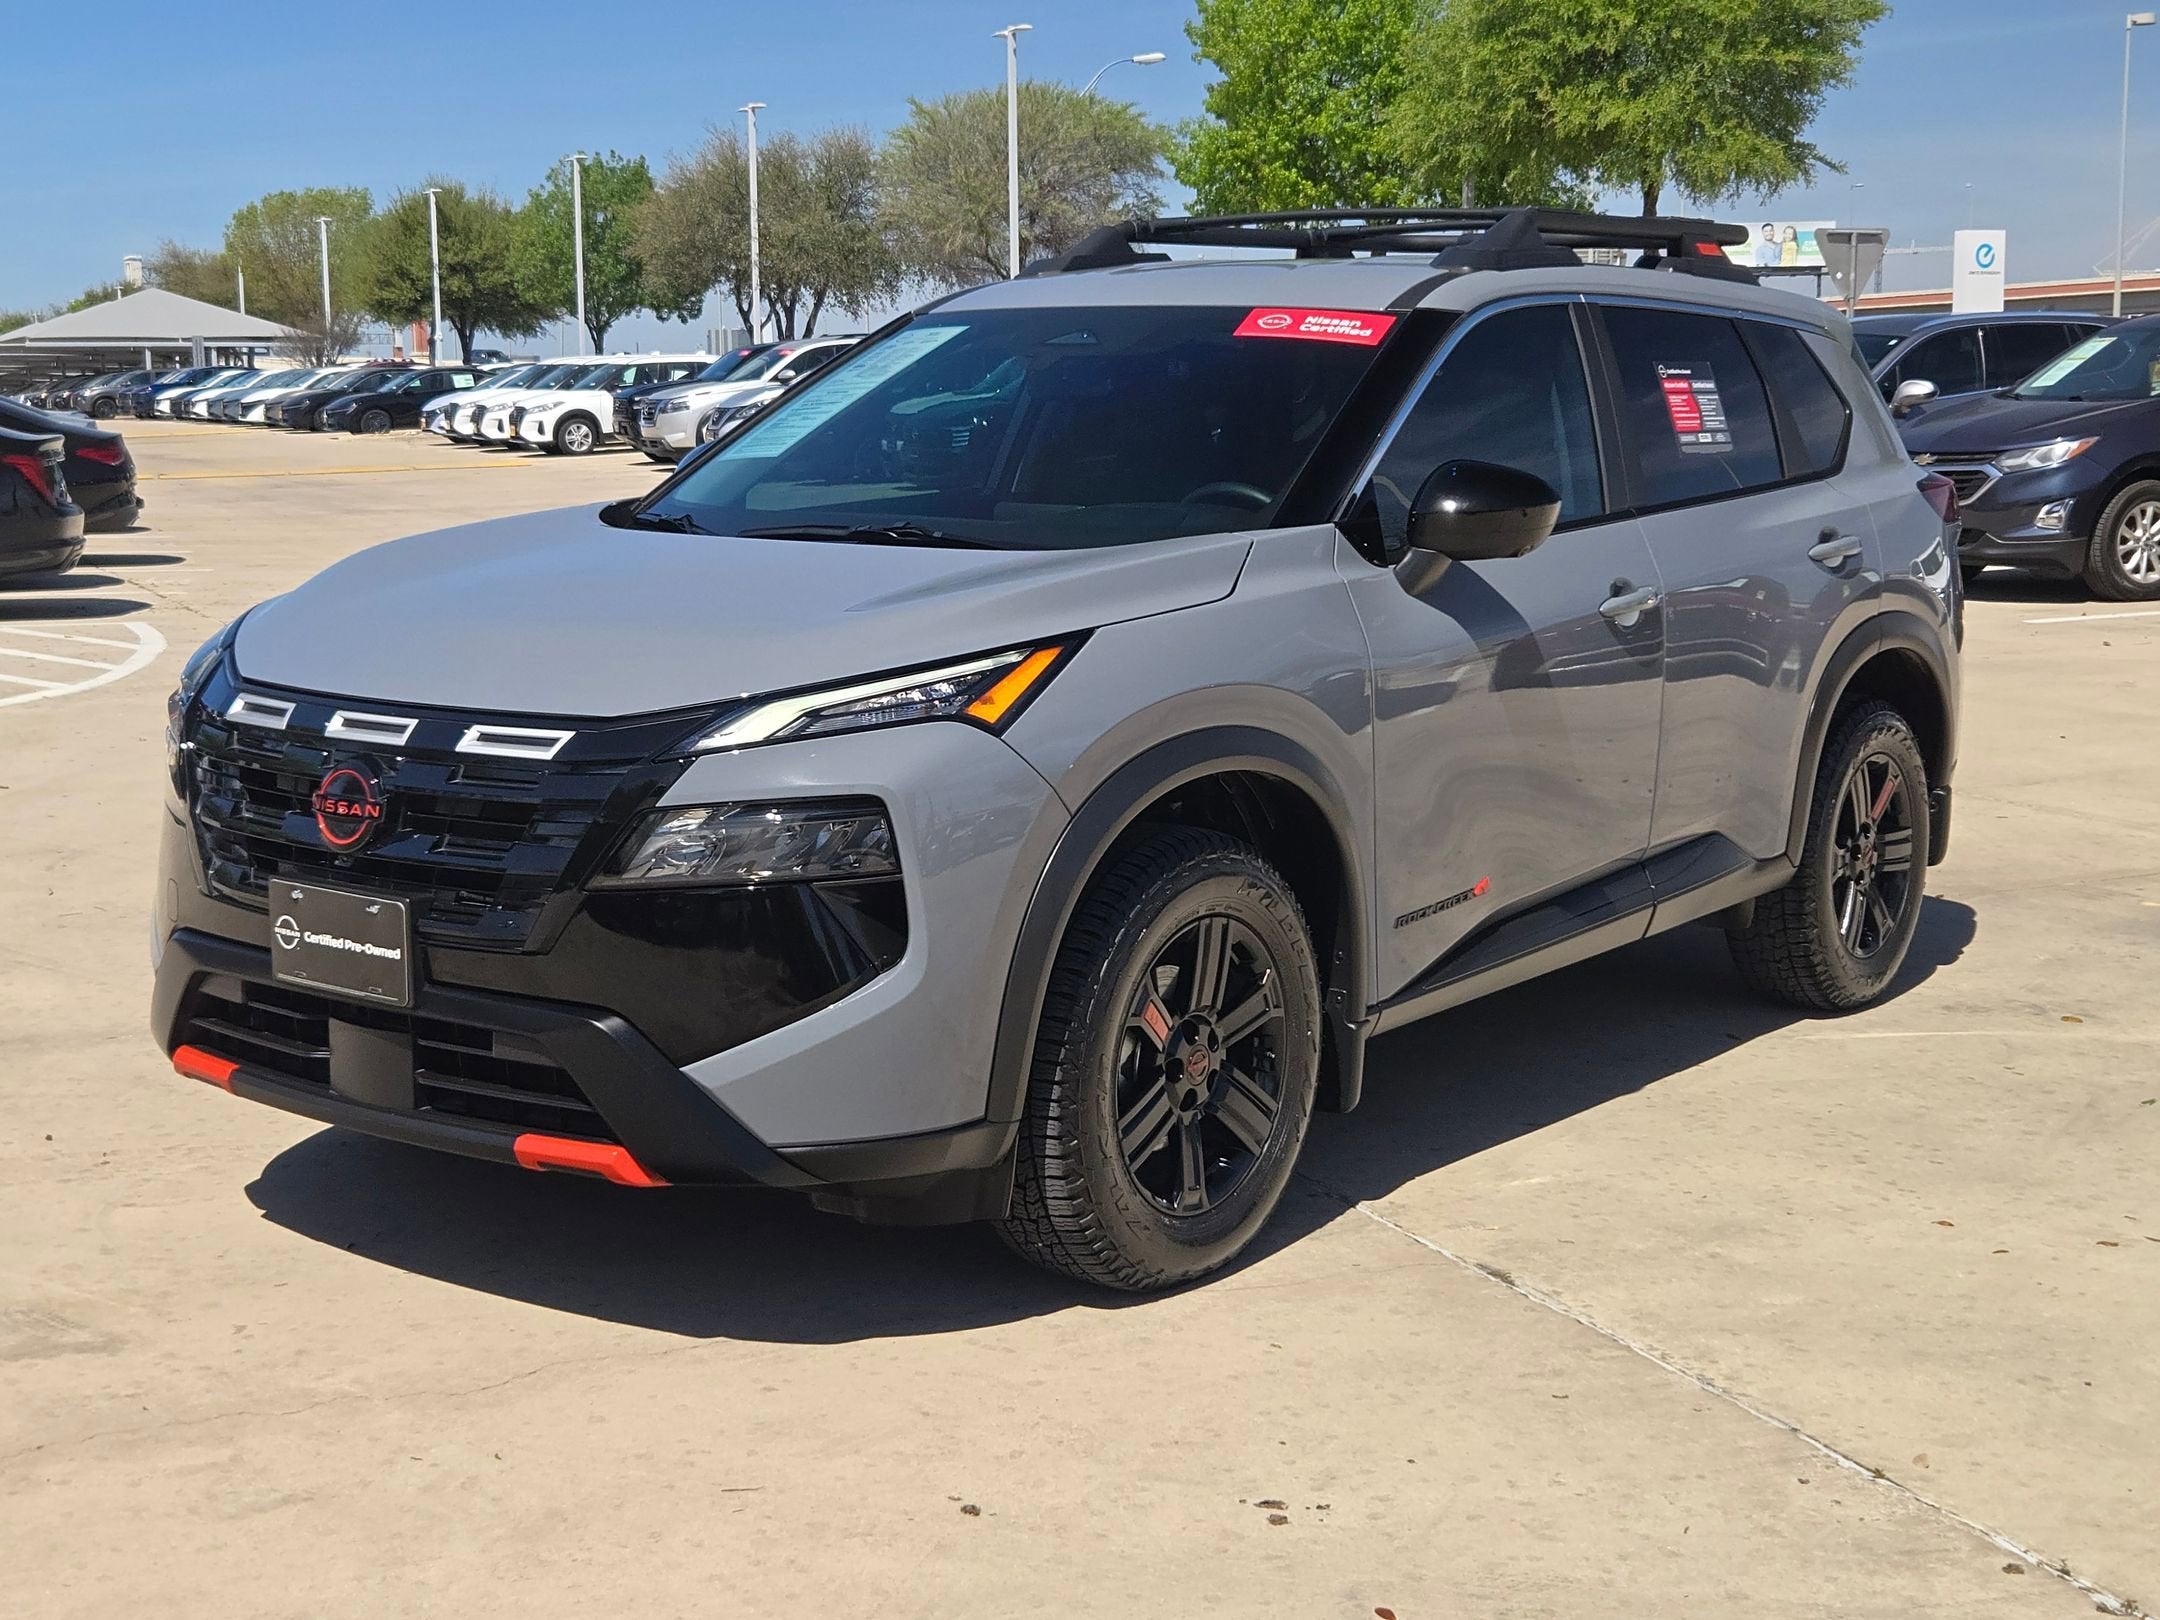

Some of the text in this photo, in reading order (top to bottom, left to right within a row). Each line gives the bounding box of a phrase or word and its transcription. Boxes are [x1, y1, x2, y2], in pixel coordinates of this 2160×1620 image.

[1299, 323, 1373, 337] Certified
[1304, 316, 1362, 328] Nissan
[312, 795, 380, 818] NISSAN
[274, 926, 401, 960] NISSAN Certified Pre-Owned
